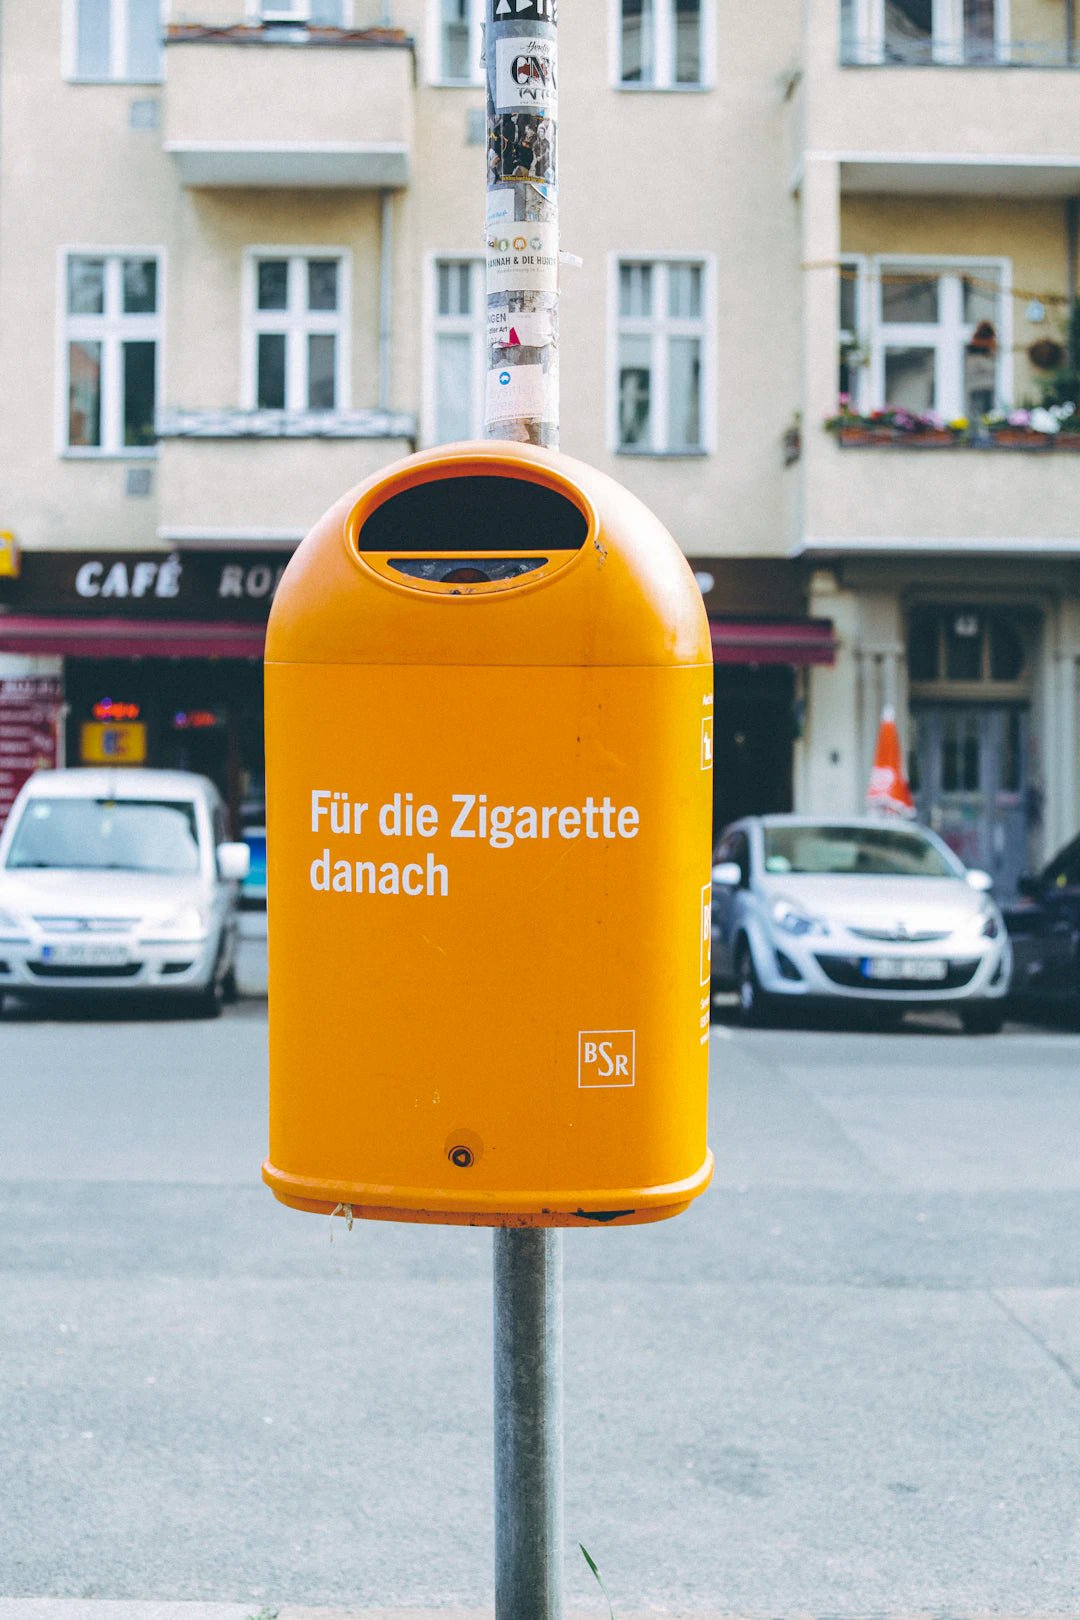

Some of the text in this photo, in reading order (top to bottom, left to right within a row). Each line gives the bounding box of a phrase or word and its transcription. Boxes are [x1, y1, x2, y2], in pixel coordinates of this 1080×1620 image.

[522, 255, 535, 265] DIE
[75, 552, 281, 599] CAFÉ RO
[311, 789, 640, 849] Für die Zigarette
[310, 848, 449, 897] danach
[584, 1041, 629, 1077] BSR
